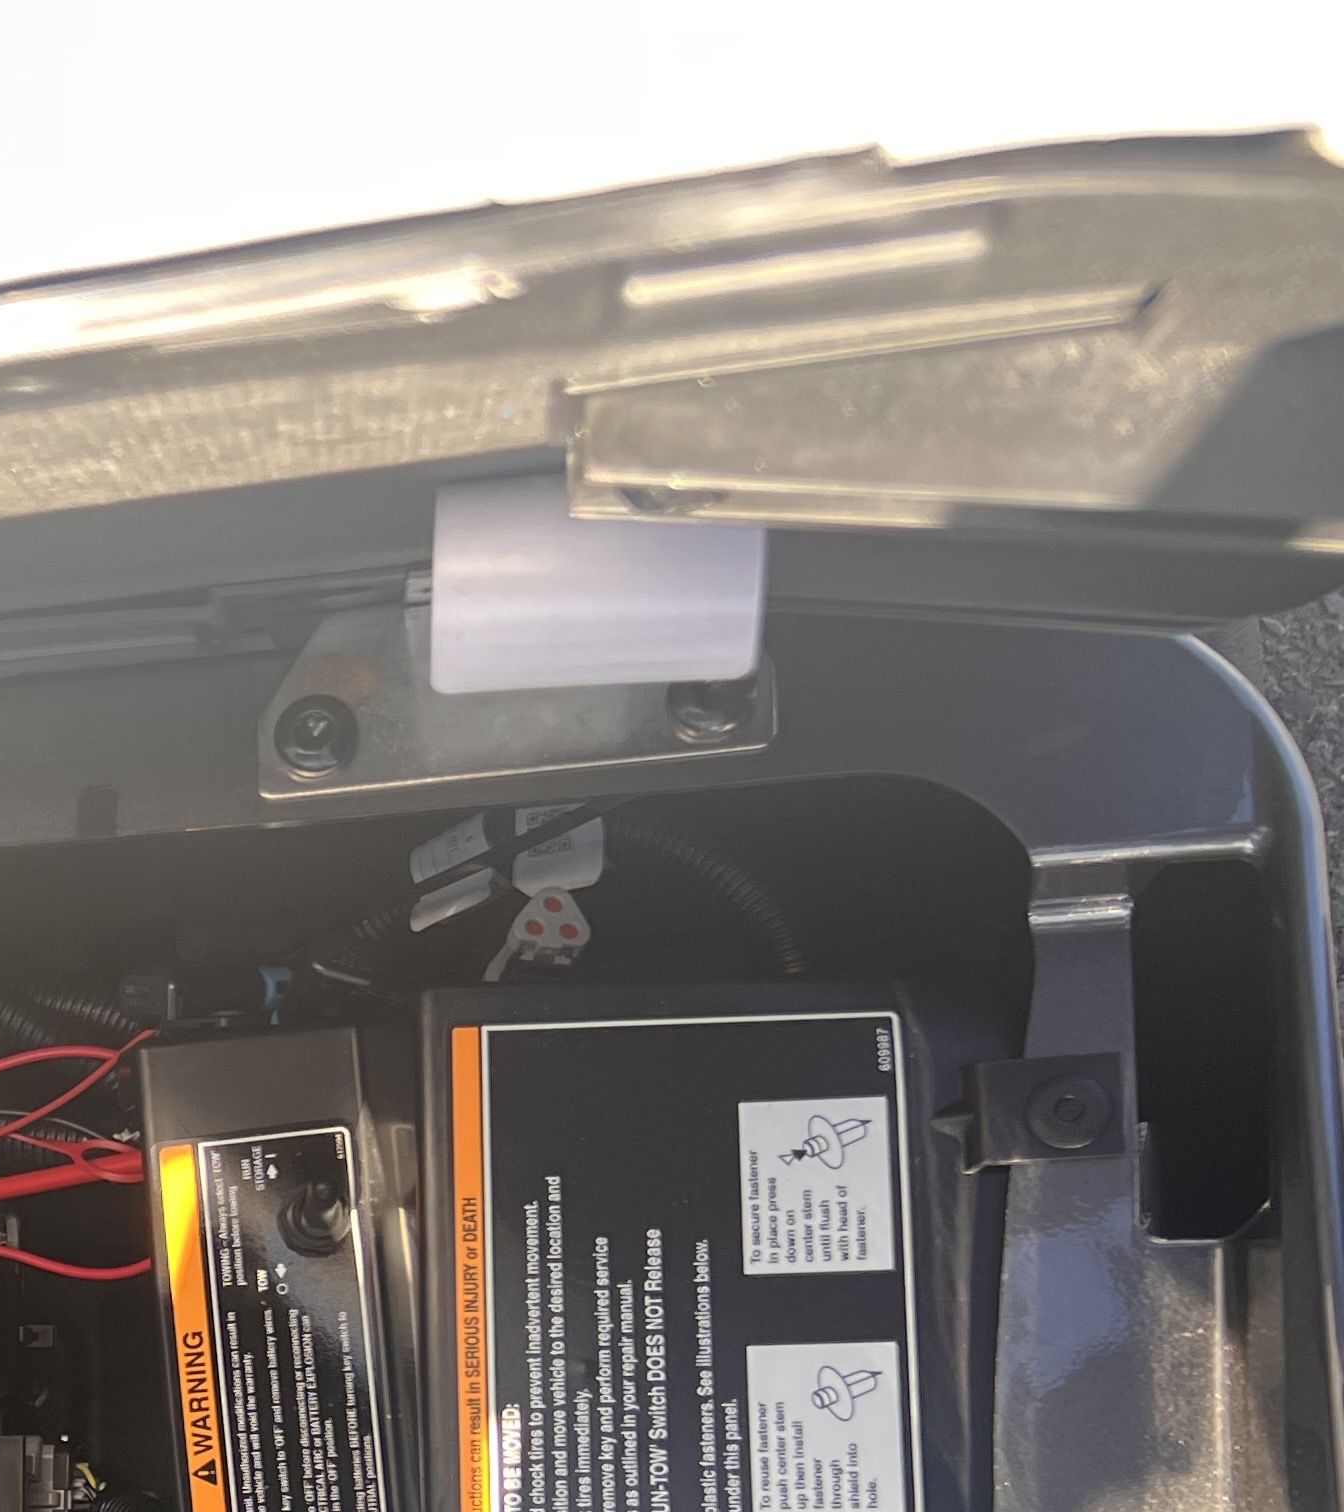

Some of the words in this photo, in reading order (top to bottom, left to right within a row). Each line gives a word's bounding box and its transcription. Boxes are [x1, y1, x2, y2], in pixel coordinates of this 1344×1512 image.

[876, 1027, 892, 1070] 609987
[240, 1158, 251, 1179] RUN
[251, 1145, 265, 1190] STORAGE
[746, 1150, 759, 1199] fastener
[545, 1176, 561, 1201] and
[767, 1177, 779, 1210] press
[801, 1189, 812, 1219] stem
[835, 1185, 847, 1197] of
[461, 1197, 478, 1241] DEATH
[750, 1203, 761, 1245] secure
[786, 1209, 795, 1225] on
[818, 1199, 830, 1230] flush
[835, 1201, 848, 1231] head
[523, 1201, 540, 1273] movement.
[545, 1205, 562, 1258] location
[766, 1215, 780, 1248] place
[784, 1229, 796, 1262] down
[802, 1224, 814, 1262] center
[819, 1234, 831, 1261] until
[837, 1235, 849, 1260] with
[854, 1206, 868, 1260] fastener.
[466, 1246, 477, 1259] or
[642, 1229, 663, 1290] Release
[749, 1249, 761, 1263] To
[767, 1252, 778, 1263] in
[256, 1269, 269, 1291] TOW
[462, 1264, 479, 1312] INJURY
[546, 1262, 564, 1312] desired
[523, 1277, 542, 1353] inadvertent
[616, 1280, 634, 1332] manual.
[644, 1295, 664, 1329] NOT
[547, 1316, 564, 1337] the
[463, 1316, 480, 1377] SERIOUS
[549, 1341, 564, 1354] to
[618, 1336, 638, 1376] repair
[645, 1334, 666, 1380] DOES
[182, 1331, 213, 1454] WARNING
[465, 1381, 480, 1393] in
[526, 1357, 546, 1408] prevent
[548, 1358, 566, 1405] vehicle
[622, 1379, 639, 1410] your
[466, 1398, 481, 1434] result
[528, 1412, 543, 1425] to
[553, 1410, 567, 1446] move
[620, 1414, 636, 1426] in
[646, 1386, 667, 1439] Switch
[755, 1403, 768, 1452] fastener
[773, 1401, 785, 1431] stem
[501, 1403, 522, 1464] MOVED:
[527, 1429, 544, 1459] tires
[791, 1421, 804, 1458] install
[470, 1439, 481, 1462] can
[551, 1450, 568, 1476] and
[620, 1430, 638, 1486] outlined
[775, 1436, 787, 1474] center
[846, 1443, 858, 1466] into
[503, 1466, 523, 1489] BE
[528, 1463, 545, 1503] chock
[760, 1456, 770, 1490] reuse
[793, 1462, 805, 1489] then
[810, 1458, 824, 1508] fastener
[829, 1459, 844, 1508] through
[847, 1471, 860, 1508] shield
[625, 1490, 639, 1506] as
[759, 1495, 771, 1508] To
[776, 1479, 791, 1509] push
[797, 1493, 809, 1509] up
[865, 1477, 878, 1508] hole.
